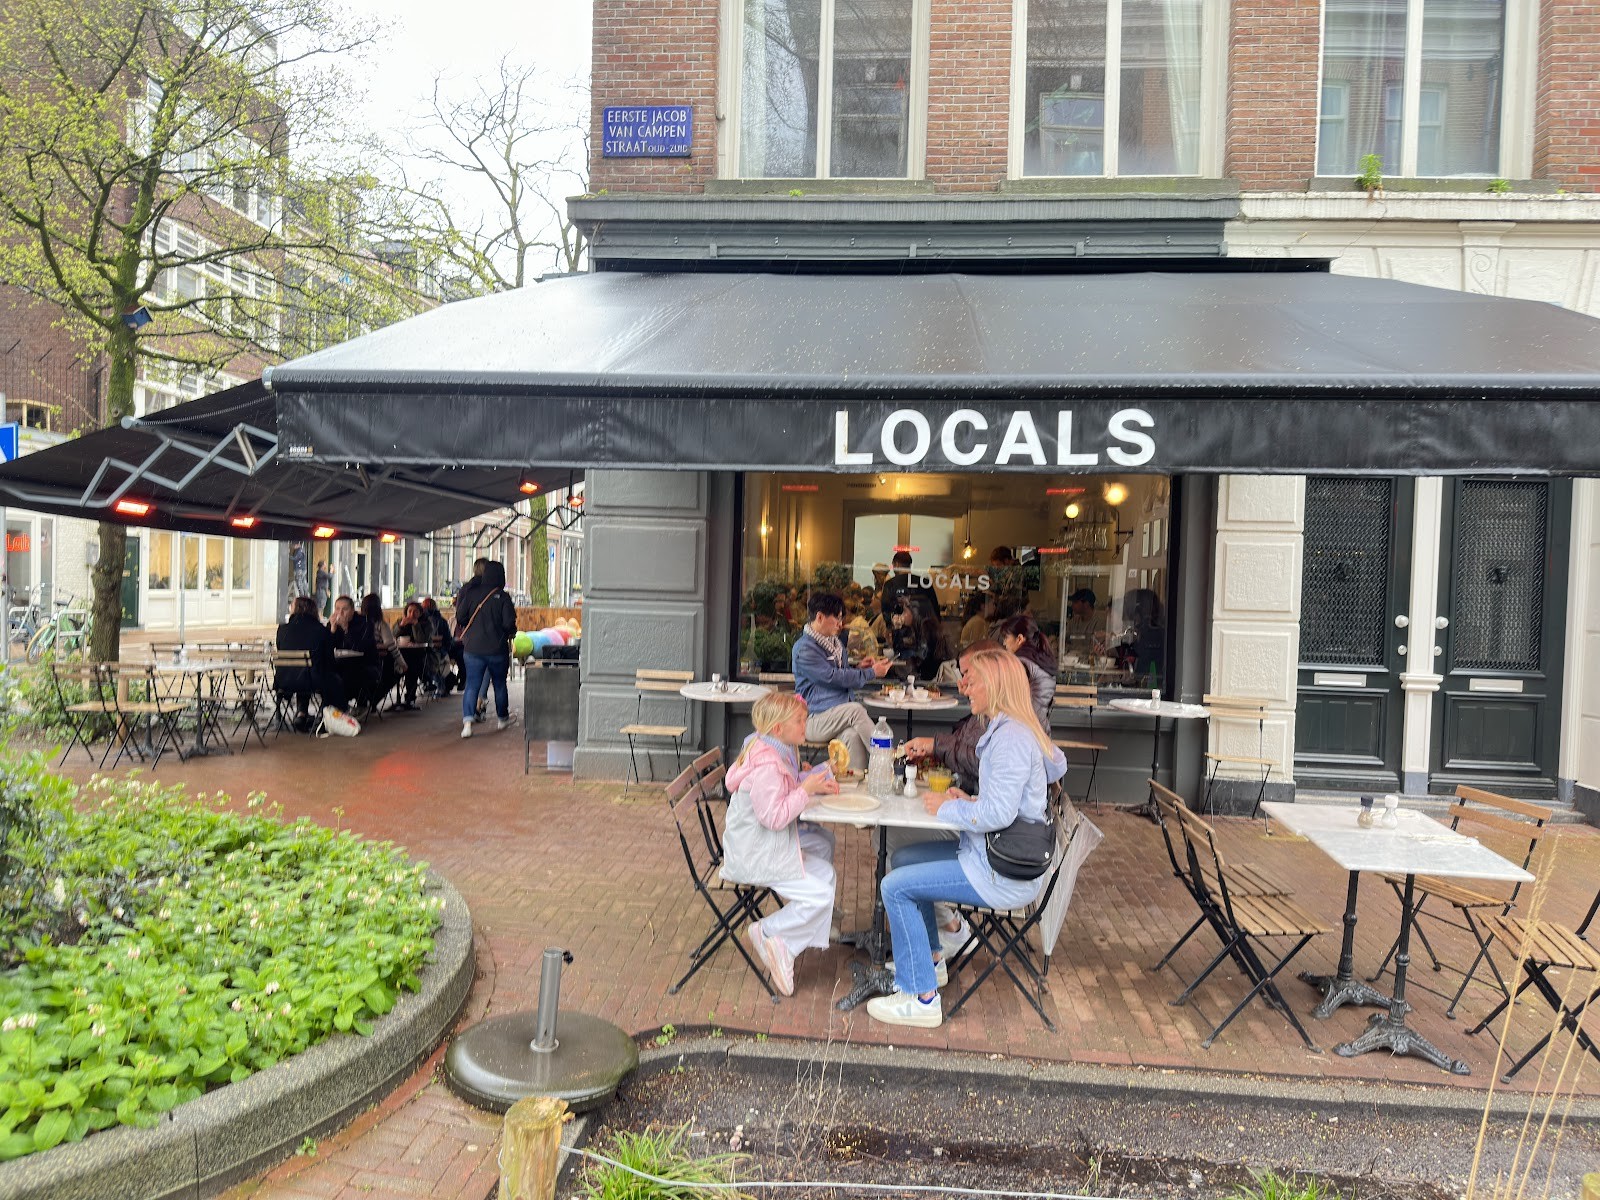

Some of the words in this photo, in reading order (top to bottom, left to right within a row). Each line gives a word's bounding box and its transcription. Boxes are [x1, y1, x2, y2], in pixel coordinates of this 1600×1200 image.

[607, 110, 648, 123] EERSTE
[651, 110, 687, 126] JACOB
[609, 125, 633, 138] VAN
[637, 125, 686, 138] CAMPEN
[605, 140, 648, 153] STRAAT
[834, 408, 1156, 467] LOCALS
[907, 572, 990, 590] LOCALS
